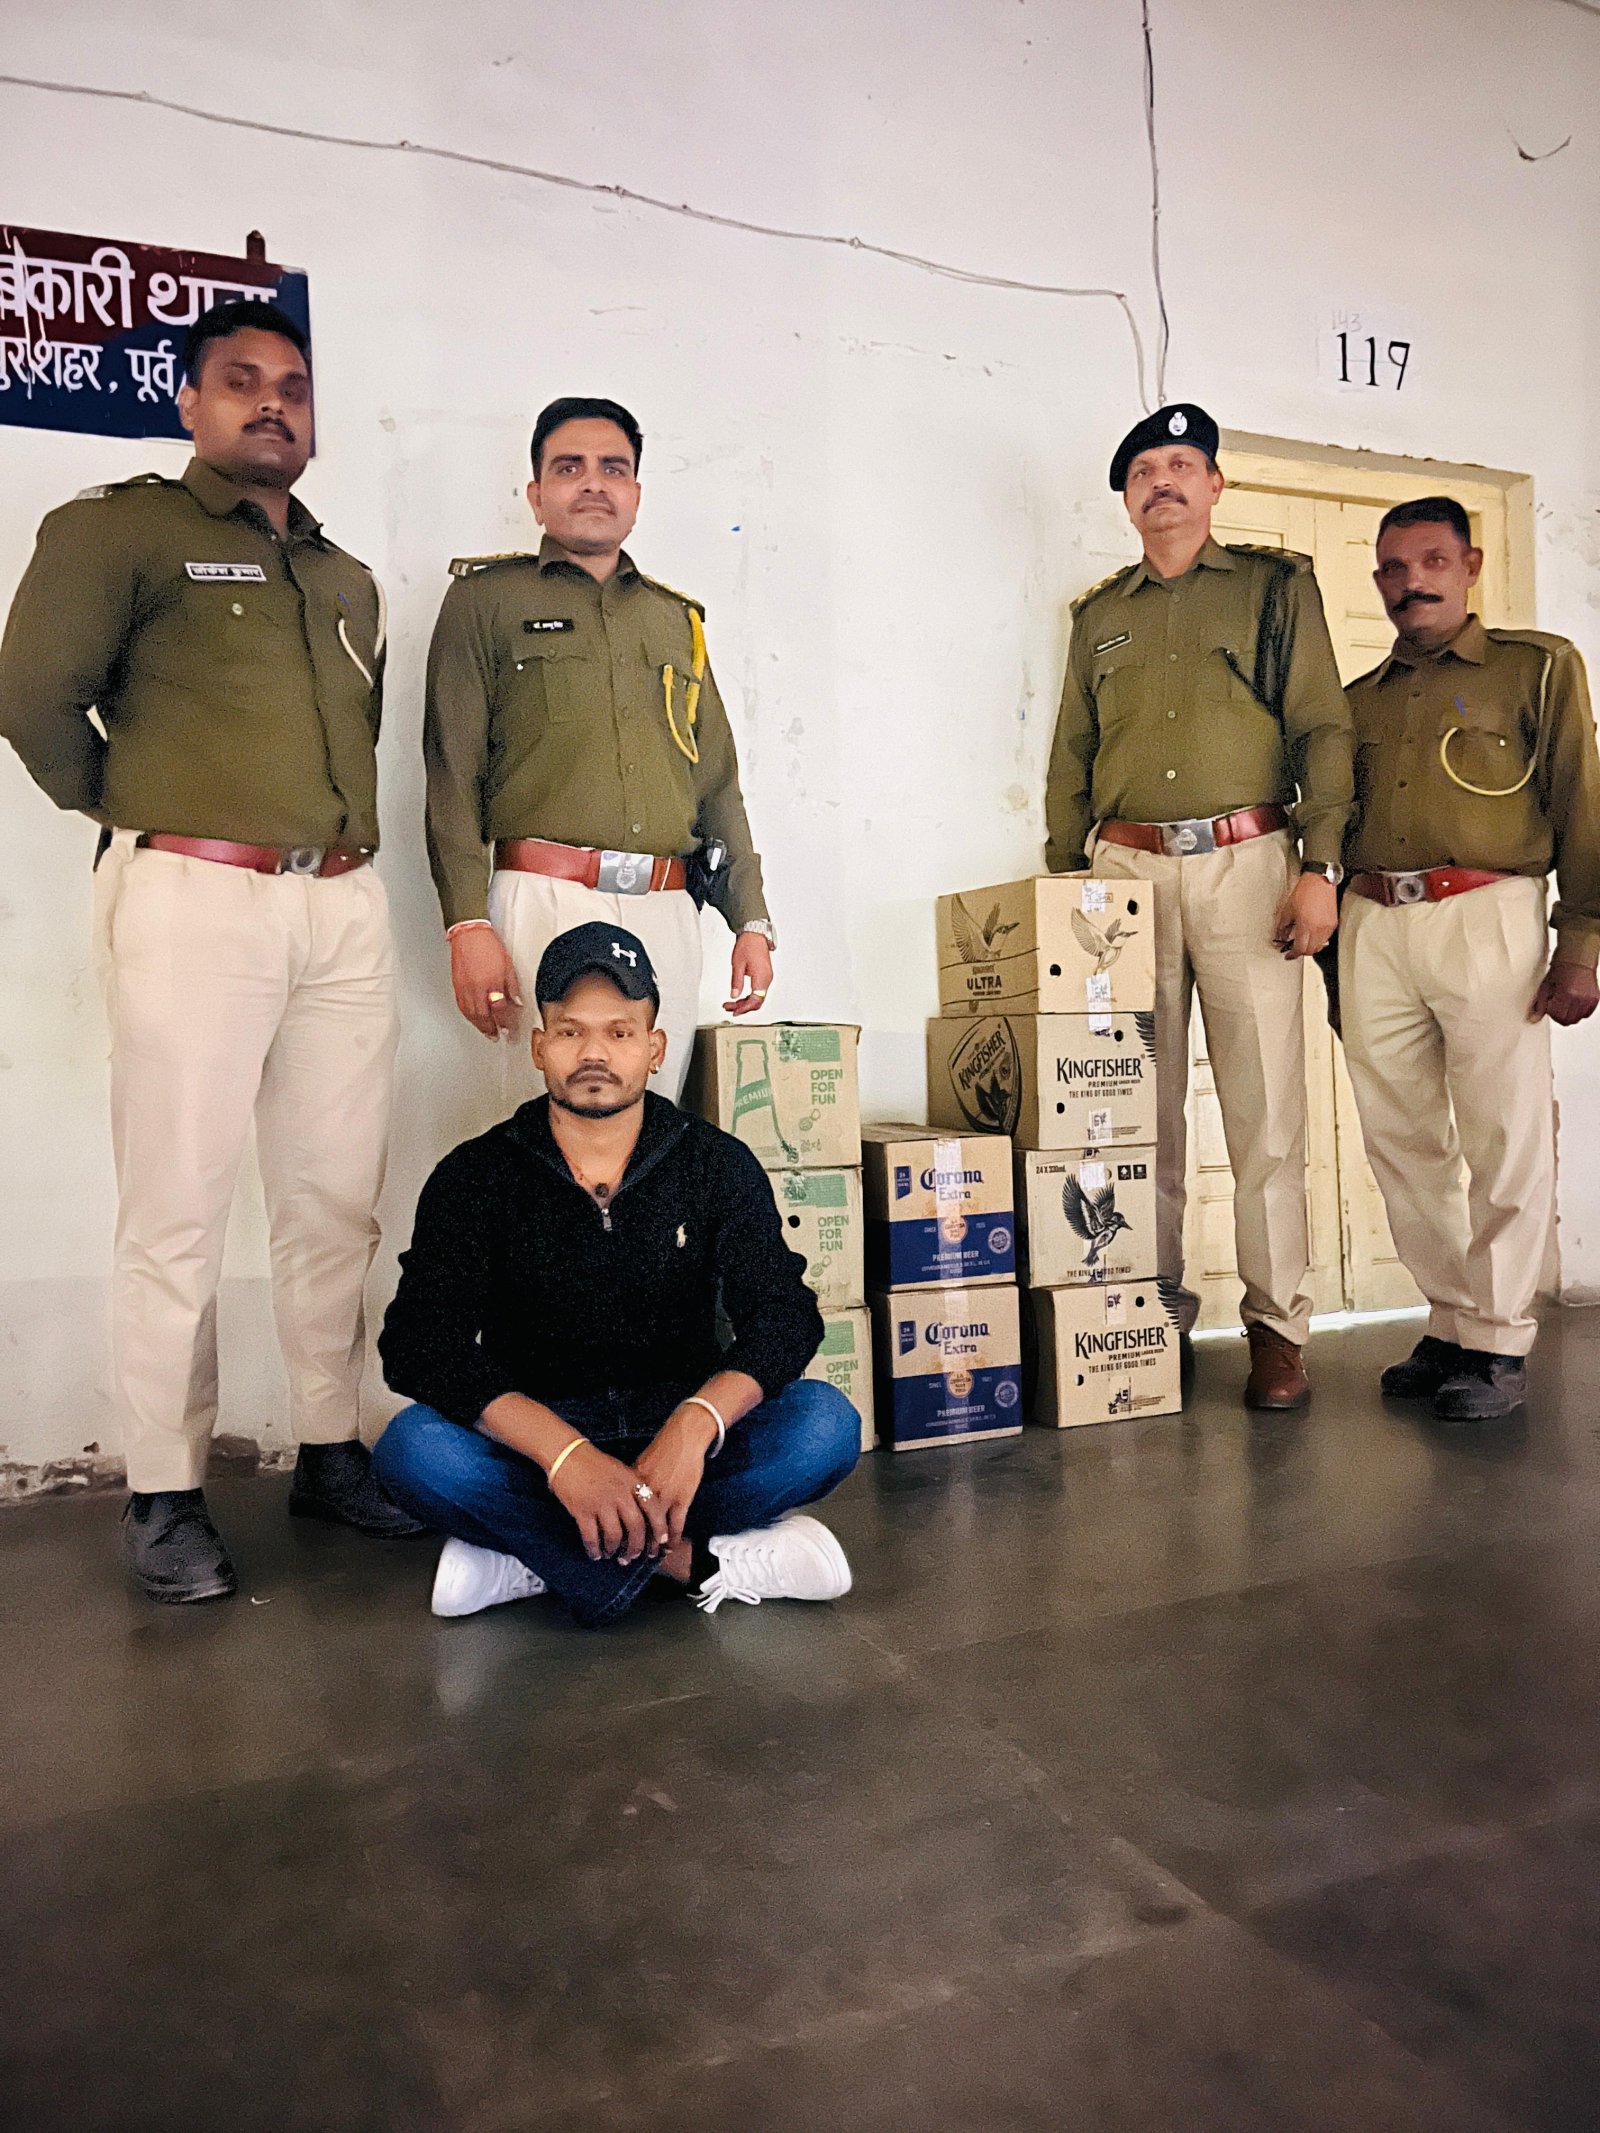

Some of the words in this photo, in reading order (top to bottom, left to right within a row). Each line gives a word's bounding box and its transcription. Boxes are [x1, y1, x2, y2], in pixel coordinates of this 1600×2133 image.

[147, 272, 278, 327] था
[1336, 332, 1411, 391] 119
[124, 339, 177, 403] पूर्व
[966, 975, 1002, 990] ULTRA
[958, 1030, 1006, 1091] KINGFISHER
[810, 1069, 843, 1080] OPEN
[1056, 1058, 1144, 1084] KINGFISHER
[811, 1082, 836, 1093] FOR
[1088, 1080, 1118, 1088] PREMIUM
[811, 1094, 836, 1105] FUN
[1069, 1090, 1079, 1098] THE
[1080, 1090, 1093, 1098] KING
[1102, 1089, 1116, 1097] GOOD
[1117, 1088, 1133, 1096] TIMES
[1036, 1165, 1044, 1174] 24
[920, 1168, 984, 1192] Corona
[939, 1187, 971, 1201] Extra
[818, 1215, 849, 1227] OPEN
[819, 1229, 842, 1240] FOR
[820, 1241, 843, 1252] FUN
[932, 1252, 962, 1262] PREMIUM
[925, 1322, 991, 1347] Corona
[944, 1341, 977, 1355] Extra
[1075, 1327, 1168, 1359] KINGFISHER
[1108, 1351, 1140, 1361] PREMIUM
[826, 1360, 859, 1373] OPEN
[1088, 1365, 1099, 1374] THE
[1100, 1363, 1114, 1372] KING
[1115, 1362, 1122, 1370] OF
[1123, 1360, 1139, 1369] GOOD
[1140, 1358, 1156, 1367] TIMES
[828, 1374, 851, 1383] FOR
